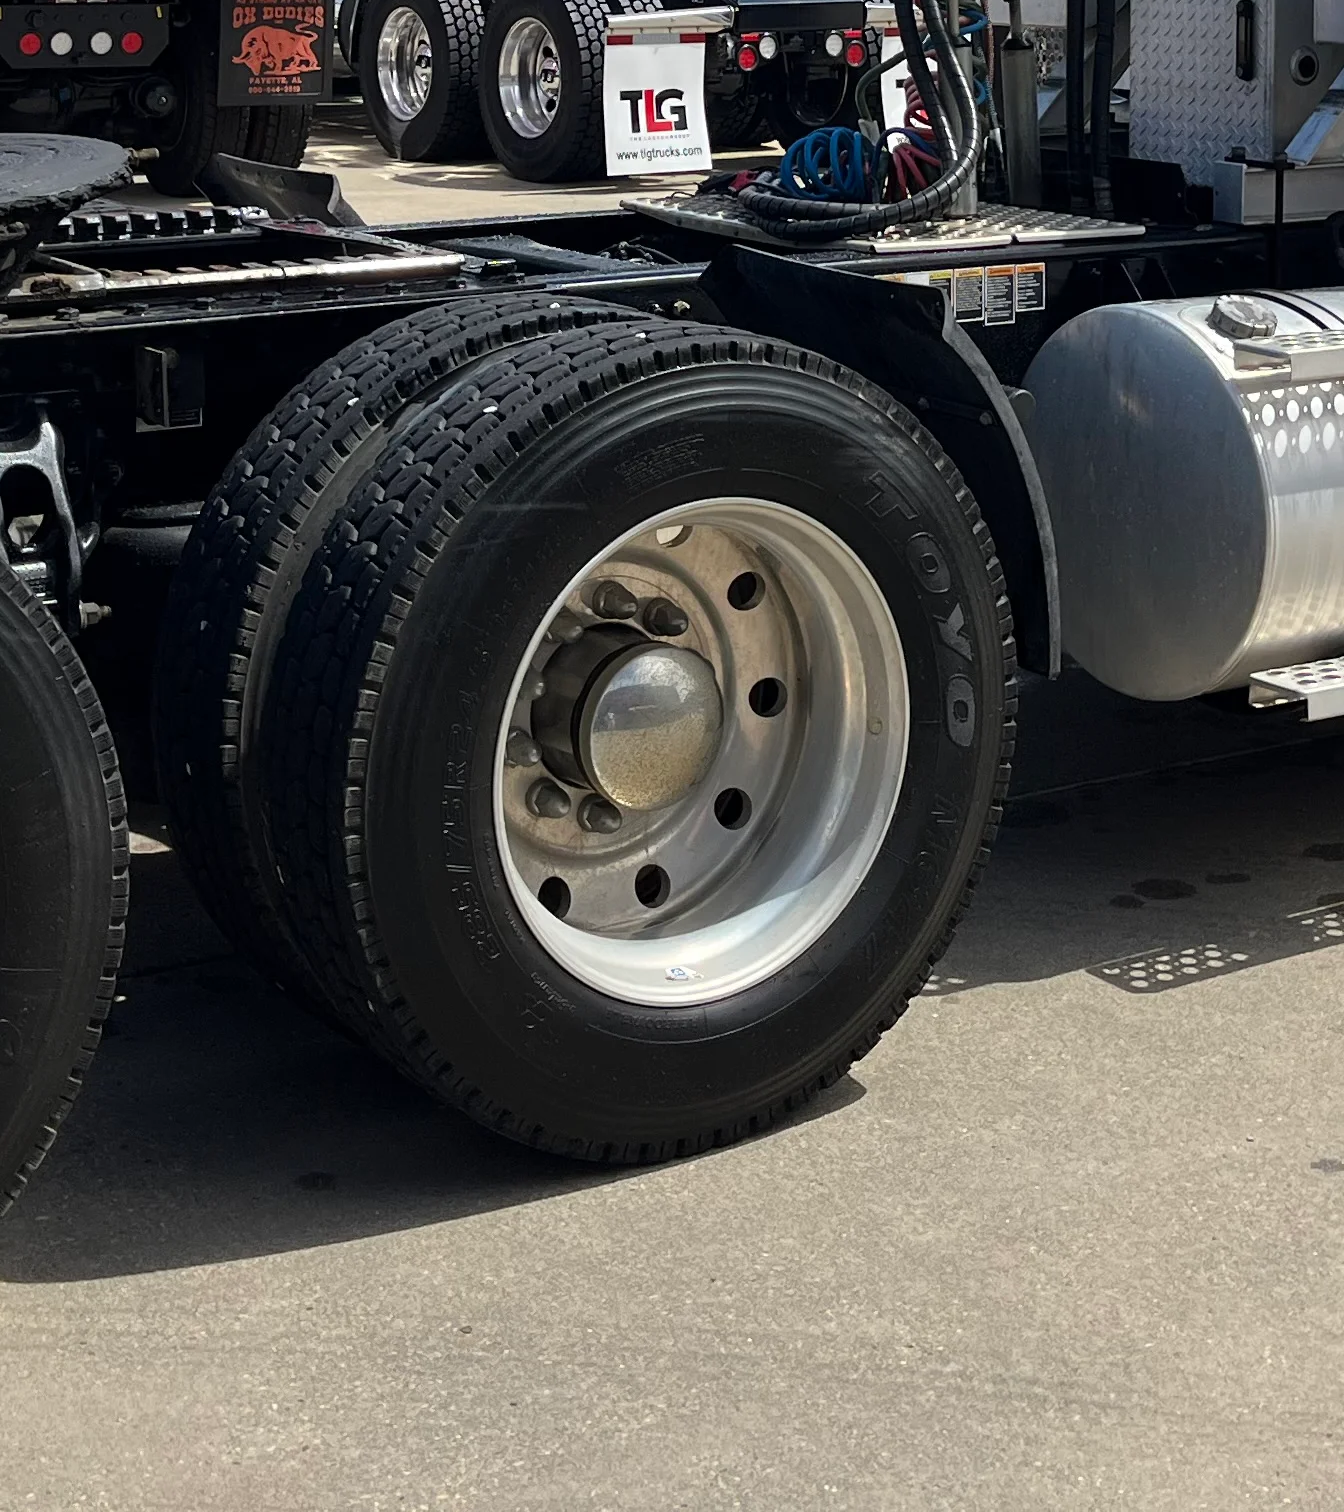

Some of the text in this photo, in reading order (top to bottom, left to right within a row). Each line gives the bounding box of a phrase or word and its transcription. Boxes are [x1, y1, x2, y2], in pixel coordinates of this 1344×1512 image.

[232, 6, 256, 28] OX
[619, 88, 688, 134] TLG
[616, 146, 703, 162] www.tlgtrucks.com
[864, 470, 977, 749] TOYO
